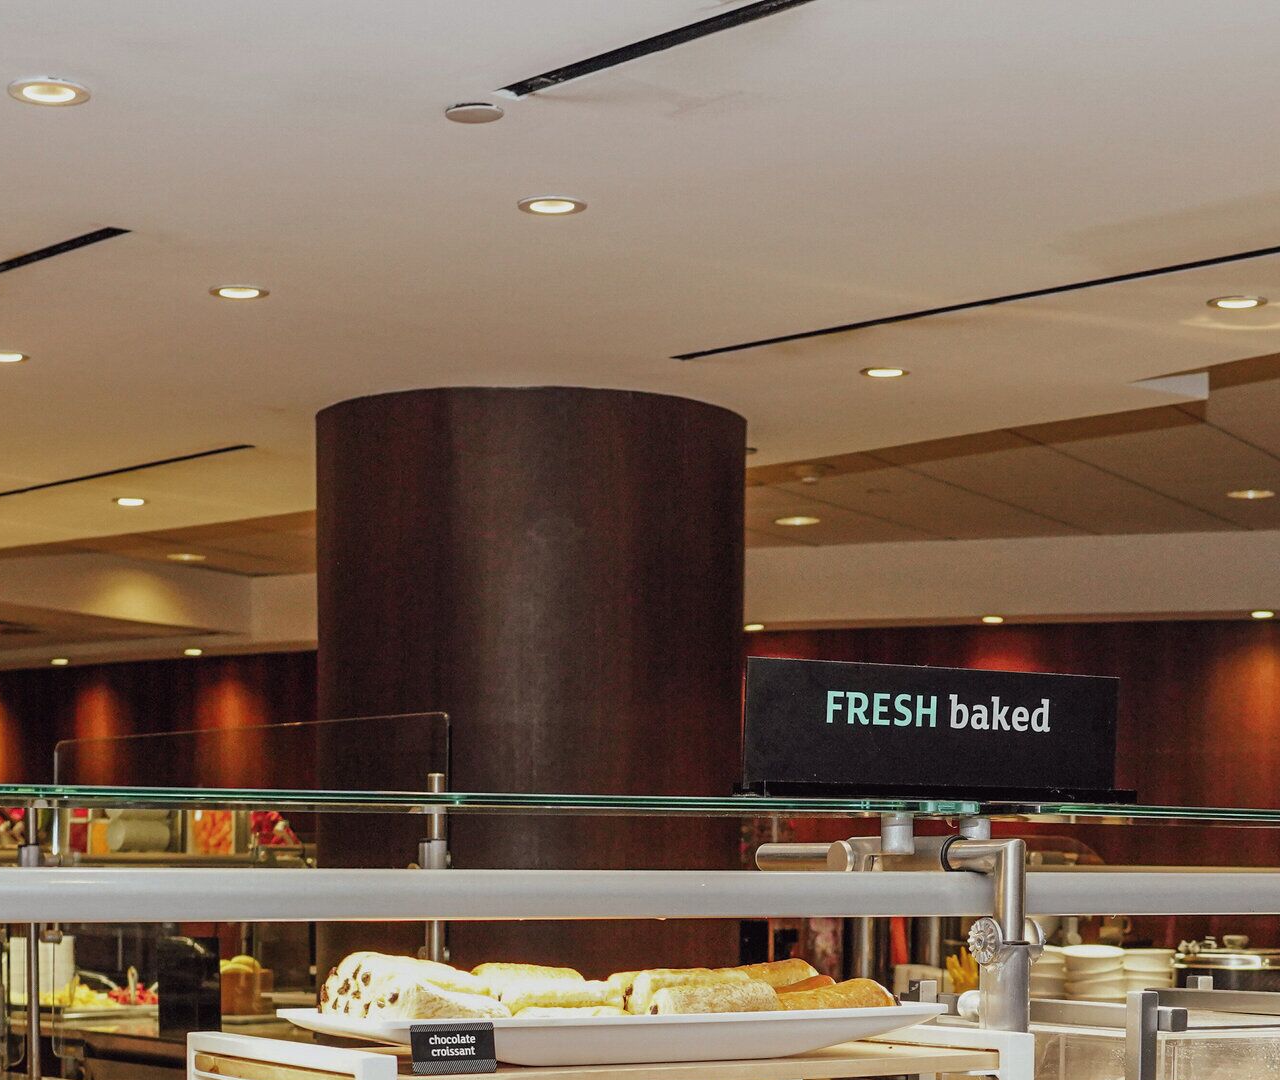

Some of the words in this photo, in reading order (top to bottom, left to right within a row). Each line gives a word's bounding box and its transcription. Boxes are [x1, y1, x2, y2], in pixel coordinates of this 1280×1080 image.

[826, 690, 938, 728] FRESH
[949, 694, 1051, 733] baked
[429, 1033, 476, 1045] chocolate
[431, 1046, 476, 1057] croissant
